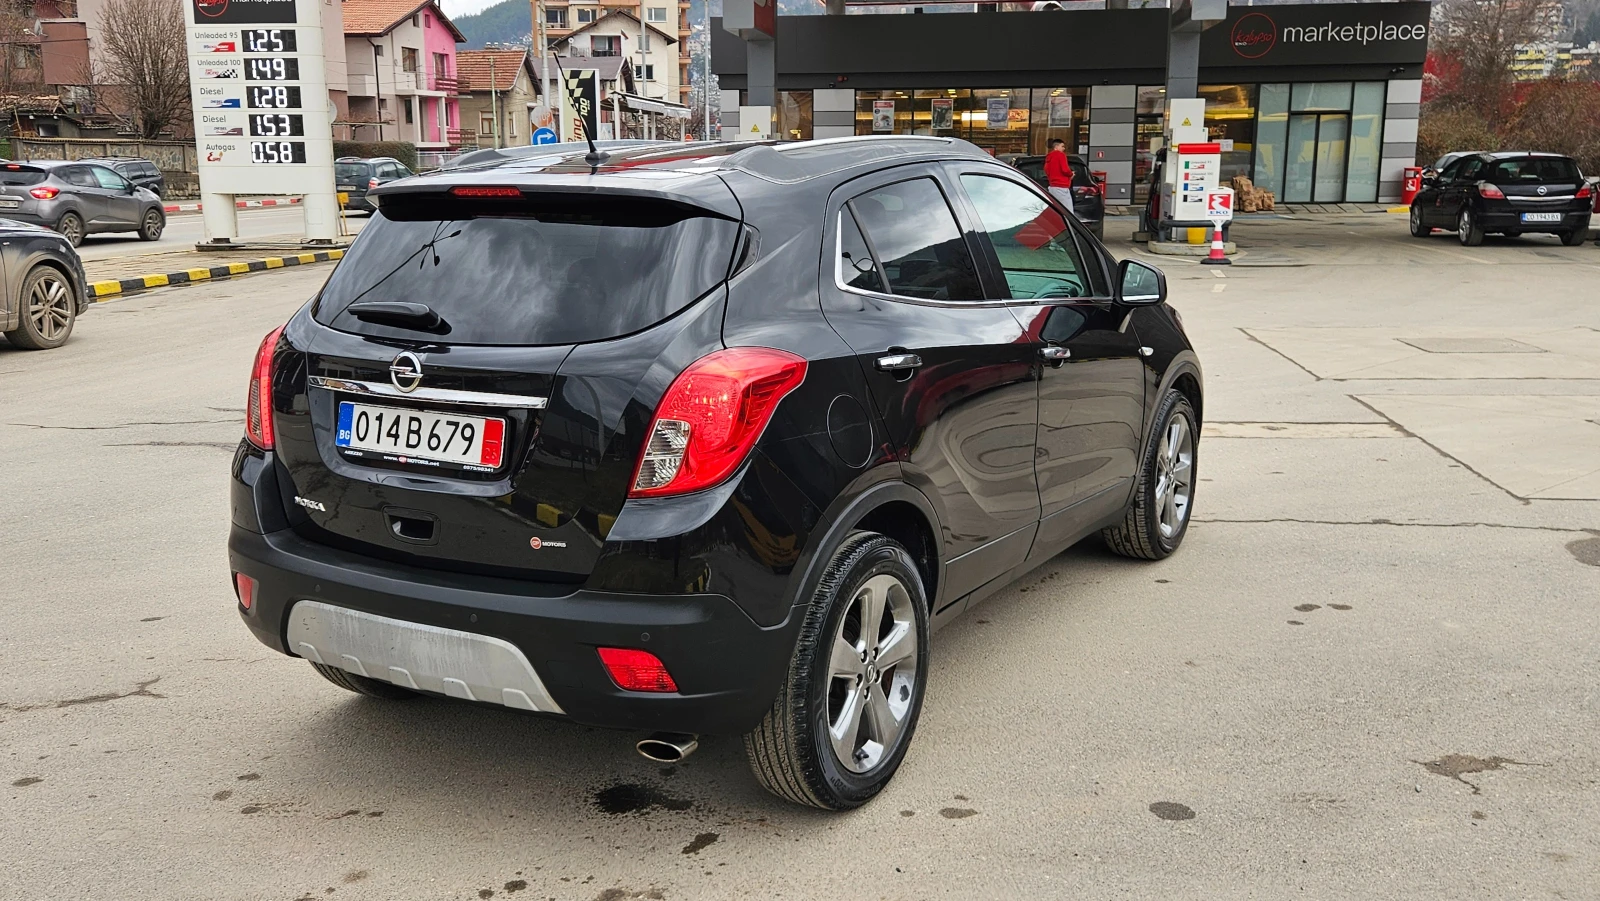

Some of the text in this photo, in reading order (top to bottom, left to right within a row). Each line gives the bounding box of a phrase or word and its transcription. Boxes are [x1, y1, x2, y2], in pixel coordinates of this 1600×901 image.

[194, 31, 239, 39] Unleaded 95
[249, 29, 284, 52] 1.25
[1283, 20, 1426, 46] marketplace
[252, 58, 286, 80] 1.49
[200, 87, 224, 95] Diesel
[254, 86, 288, 108] 1.28
[580, 97, 588, 116] 100
[202, 115, 226, 123] Diesel
[256, 114, 291, 136] 1.53
[205, 143, 236, 152] Autogas
[251, 141, 293, 163] 0.58
[339, 429, 351, 441] BG
